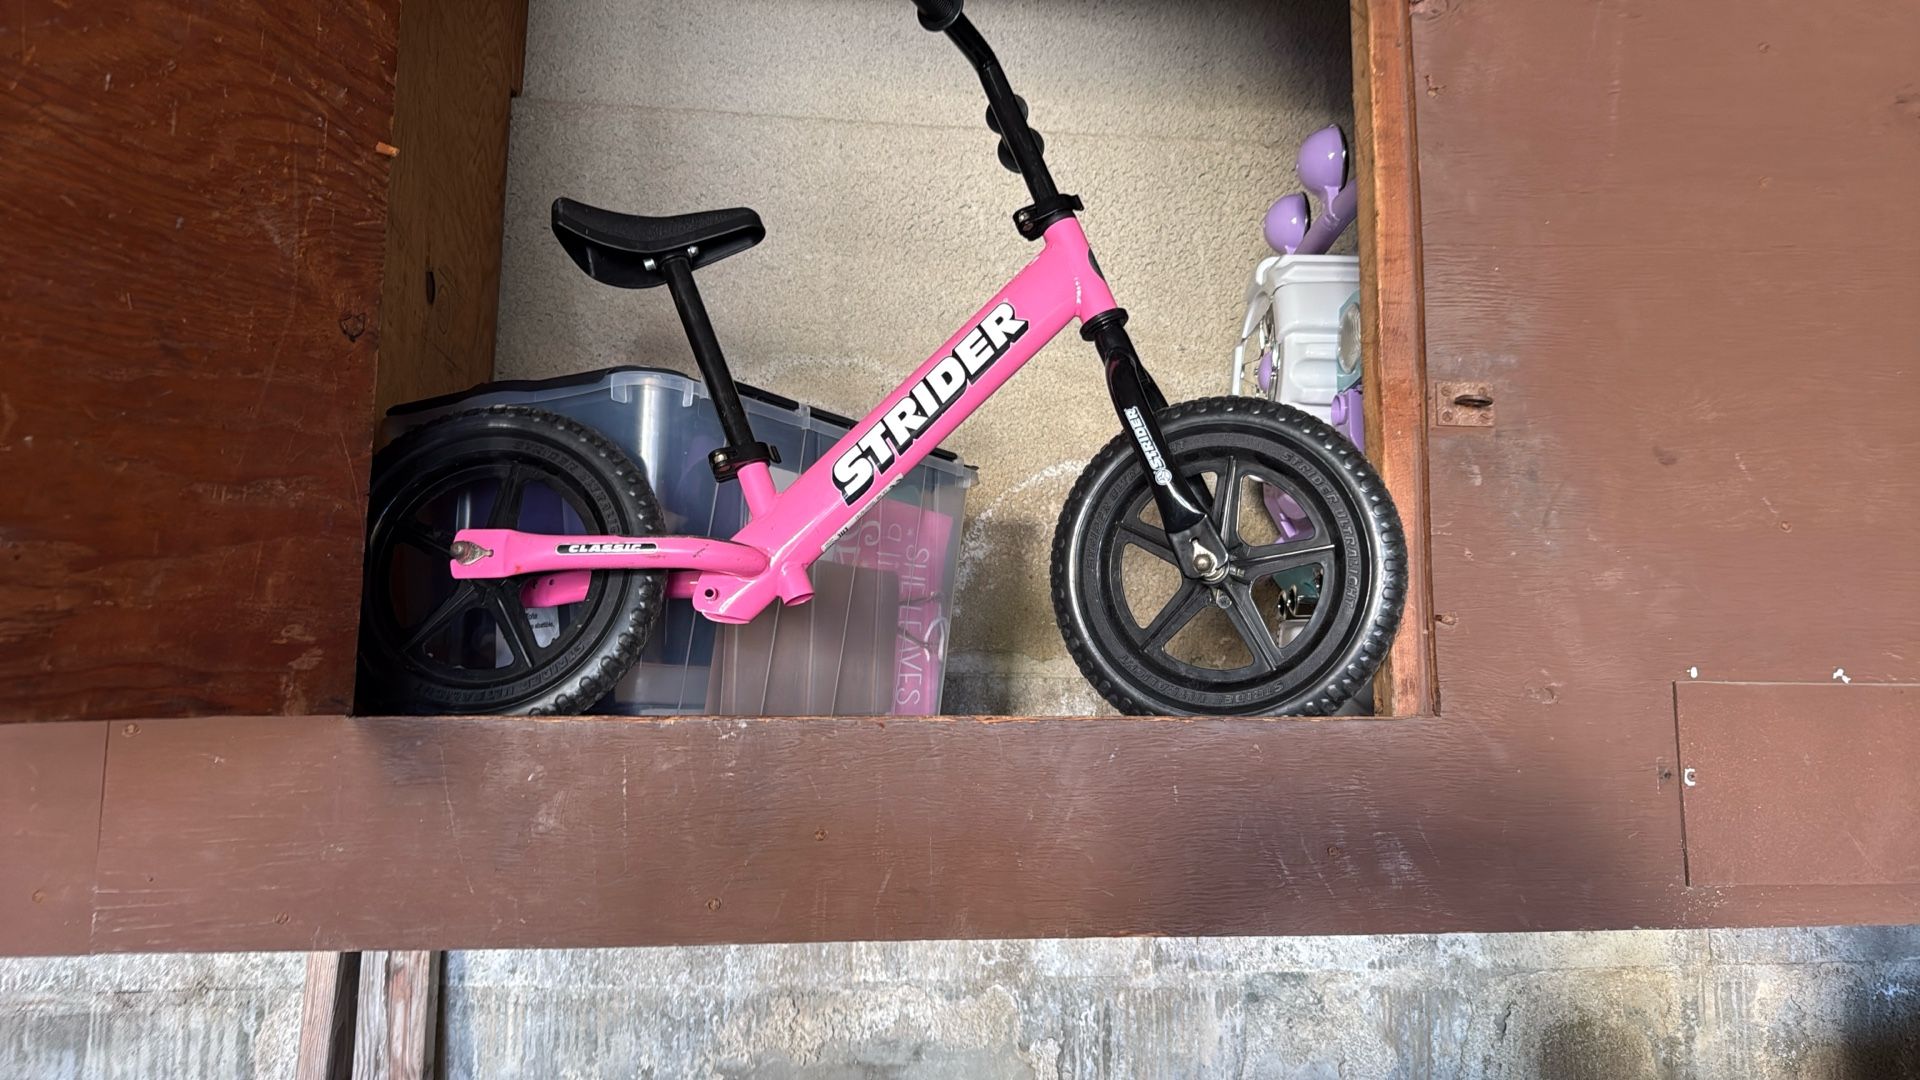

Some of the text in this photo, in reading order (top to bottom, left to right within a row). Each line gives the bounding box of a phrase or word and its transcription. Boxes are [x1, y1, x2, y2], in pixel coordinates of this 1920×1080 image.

[832, 302, 1028, 506] STRIDER
[1124, 406, 1167, 471] STRIDER
[568, 544, 641, 553] CLASSIC
[582, 473, 620, 534] ULTRALIG
[1280, 452, 1359, 609] STRIDER ULTRALIGHT
[897, 544, 930, 705] SHE LEAVES
